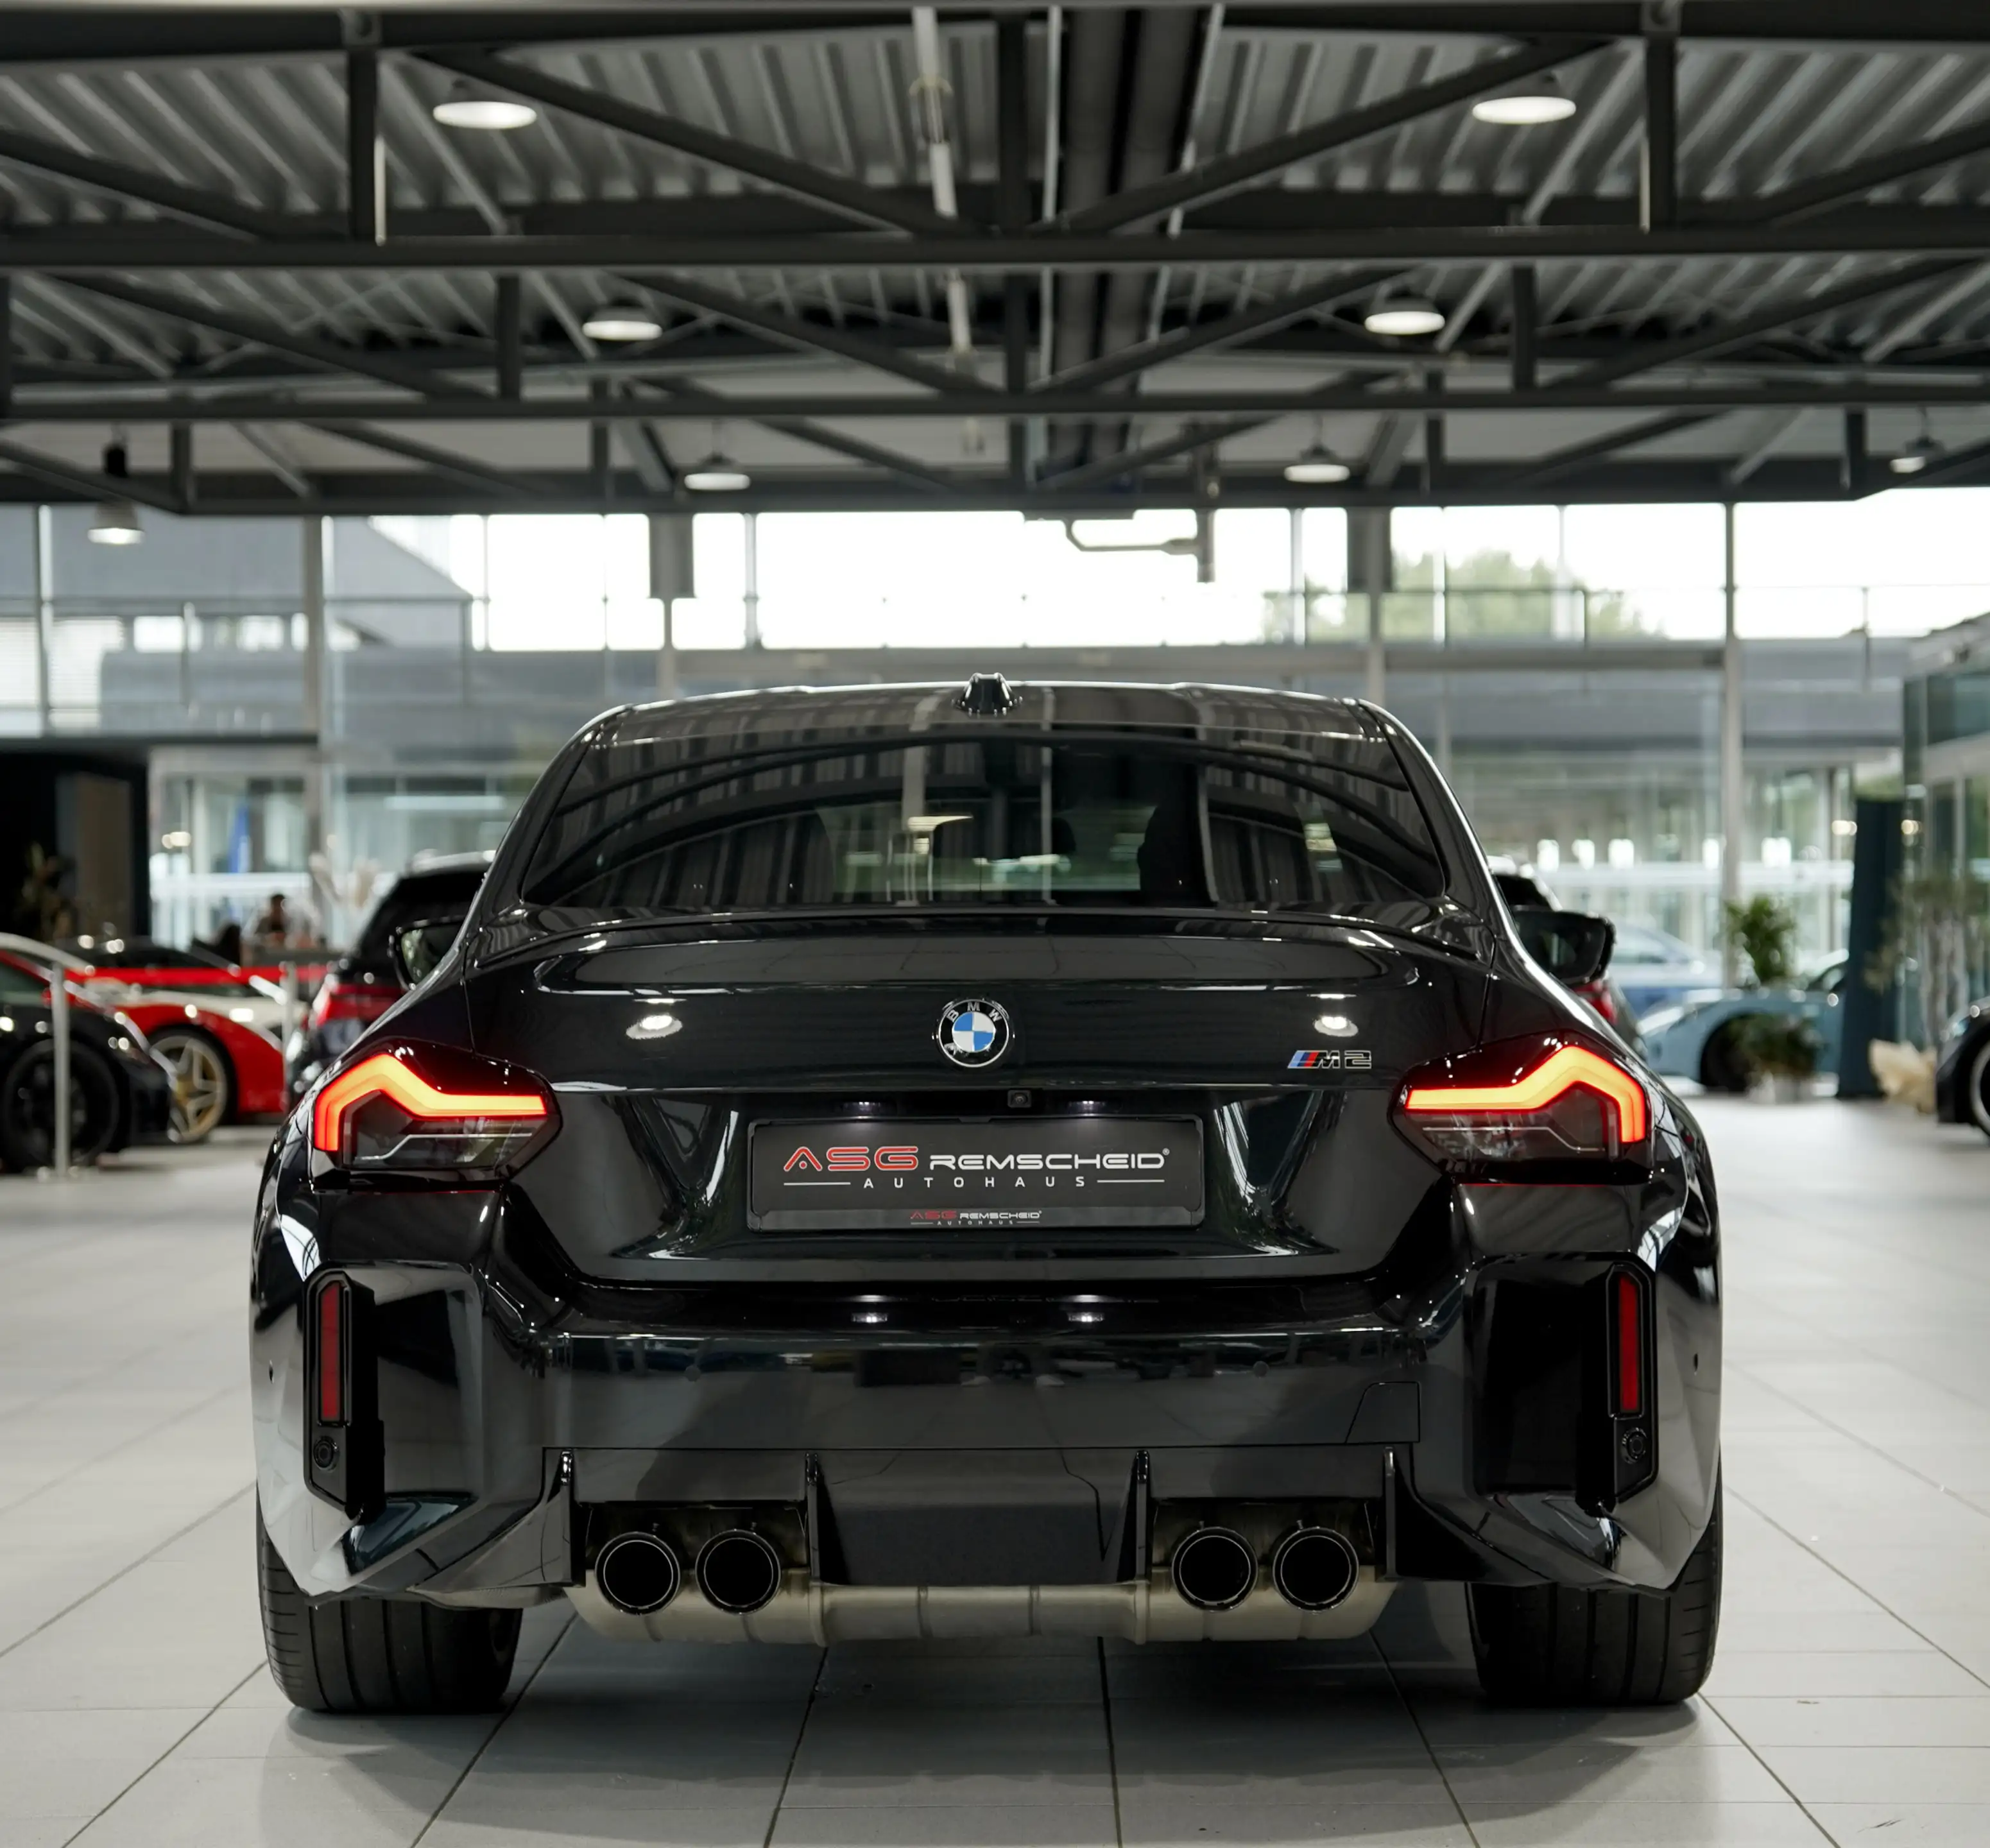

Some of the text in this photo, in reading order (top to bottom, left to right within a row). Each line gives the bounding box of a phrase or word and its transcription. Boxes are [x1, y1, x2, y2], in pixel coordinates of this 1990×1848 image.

[946, 1002, 1002, 1022] BMW
[1308, 1050, 1371, 1069] M2
[784, 1146, 918, 1172] ASG
[863, 1176, 1085, 1188] AUTOHAUS
